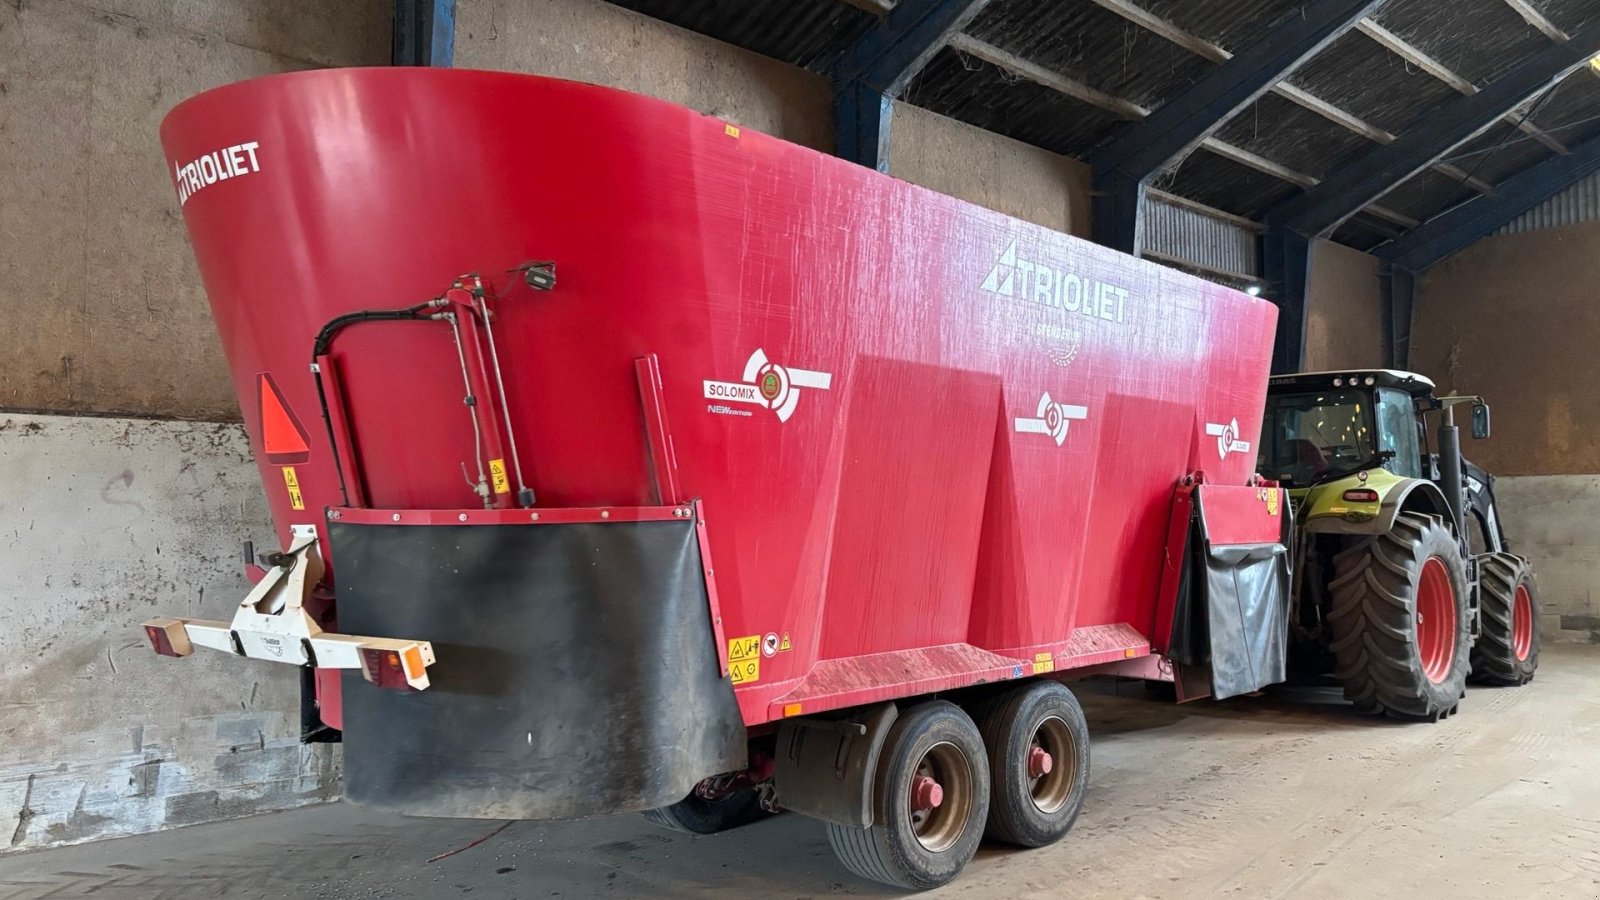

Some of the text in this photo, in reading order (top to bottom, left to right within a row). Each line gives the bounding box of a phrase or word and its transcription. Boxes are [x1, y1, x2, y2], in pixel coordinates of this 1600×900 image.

[180, 141, 260, 197] TRIOLIET
[1017, 257, 1129, 323] TRIOLIET
[708, 384, 755, 400] SOLOMIX
